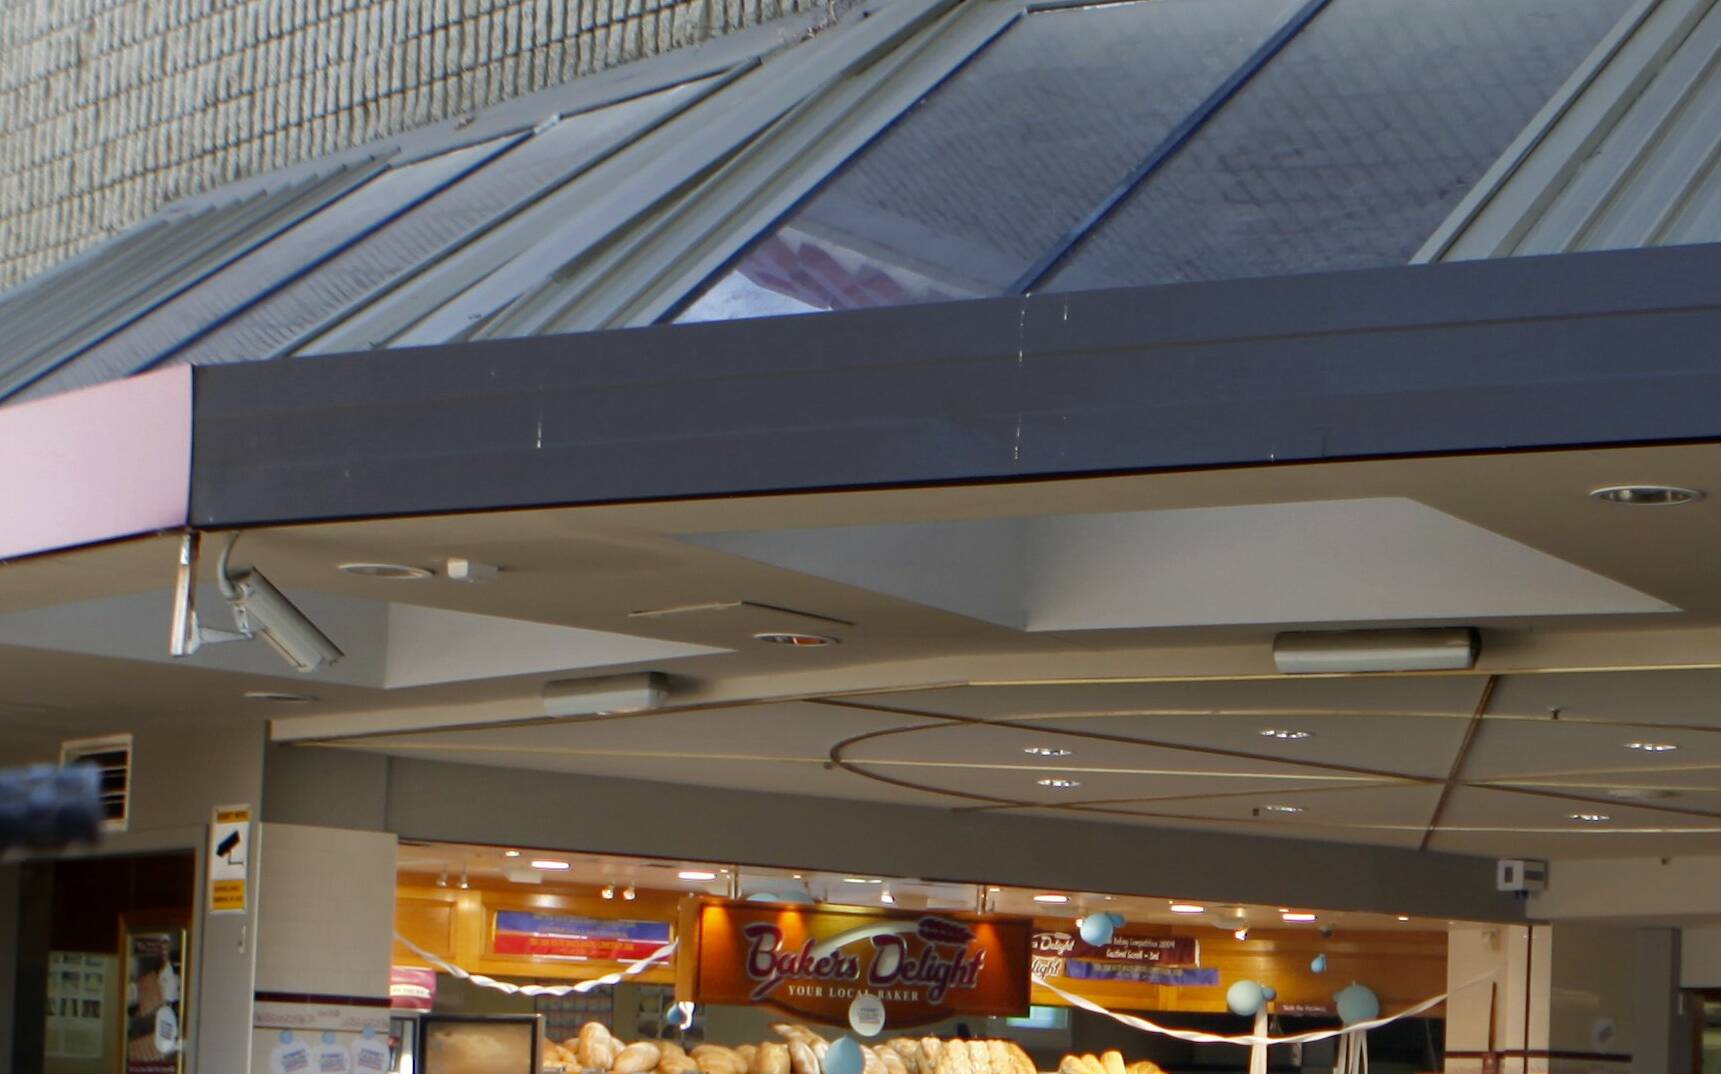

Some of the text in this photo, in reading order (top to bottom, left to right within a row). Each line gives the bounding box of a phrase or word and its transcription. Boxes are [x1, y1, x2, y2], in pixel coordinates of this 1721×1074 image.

[744, 922, 985, 1004] Bakers Delight
[1032, 960, 1060, 978] light
[788, 984, 919, 1001] YOUR LOCAL BAKER
